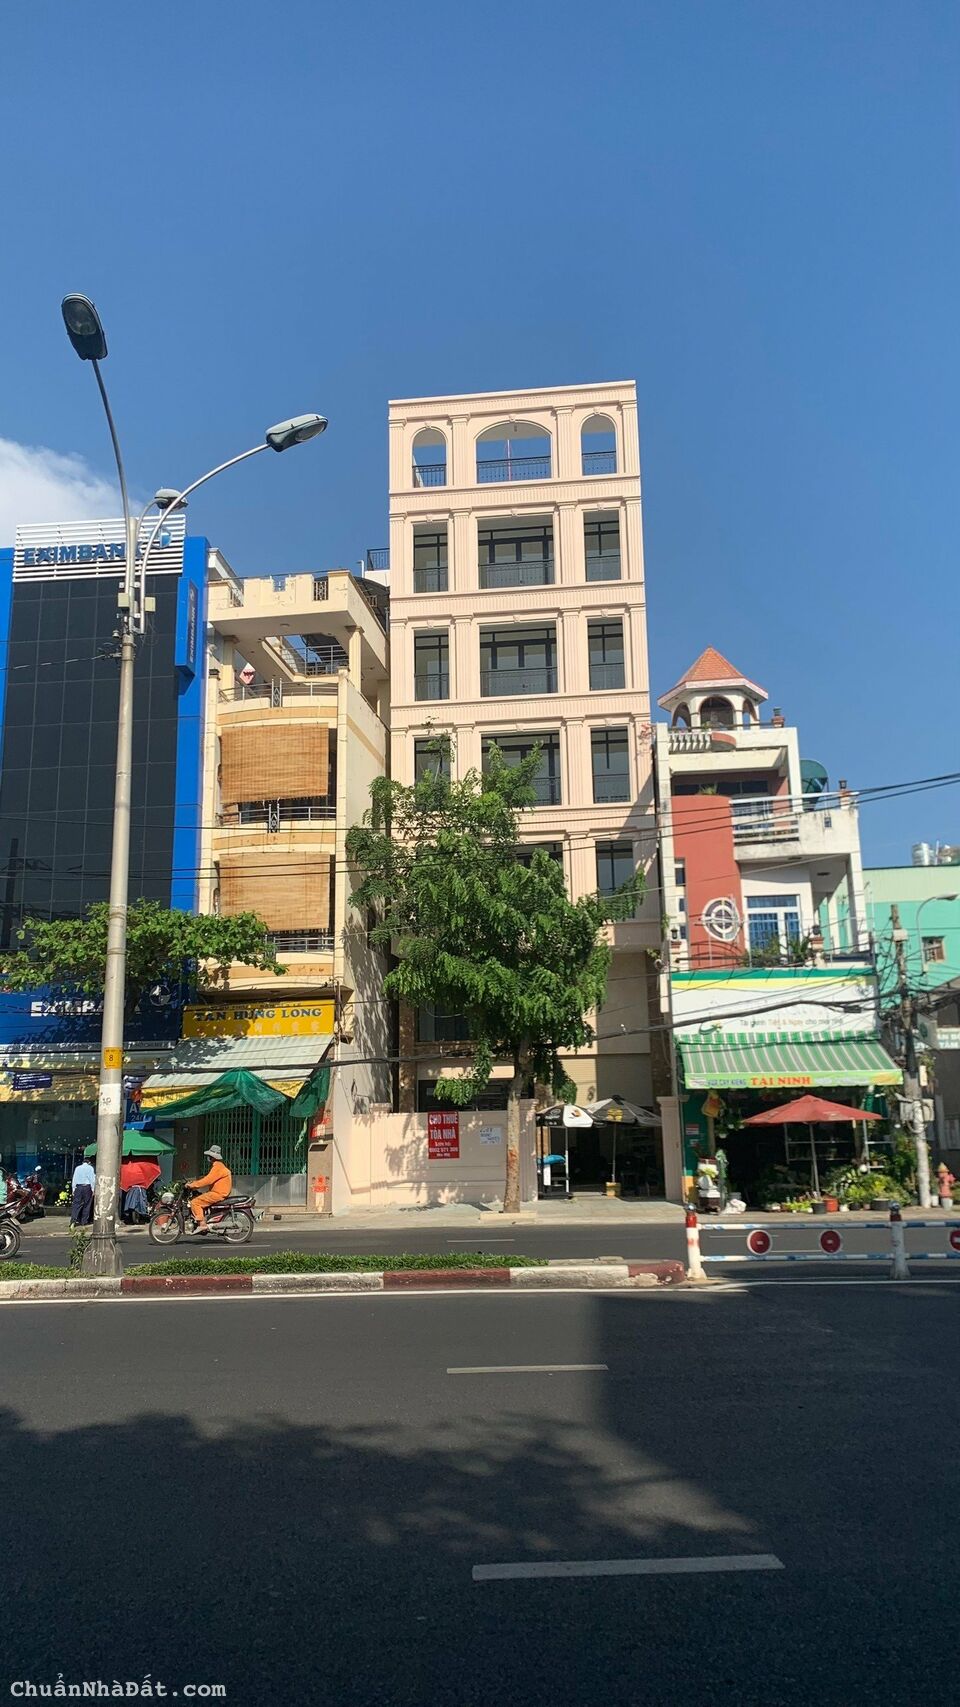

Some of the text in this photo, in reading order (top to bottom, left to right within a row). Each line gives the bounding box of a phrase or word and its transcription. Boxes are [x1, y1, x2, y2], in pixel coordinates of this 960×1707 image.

[281, 1007, 322, 1018] LONG
[108, 1054, 114, 1062] 8
[778, 1076, 811, 1085] NINH
[429, 1113, 442, 1125] CHO
